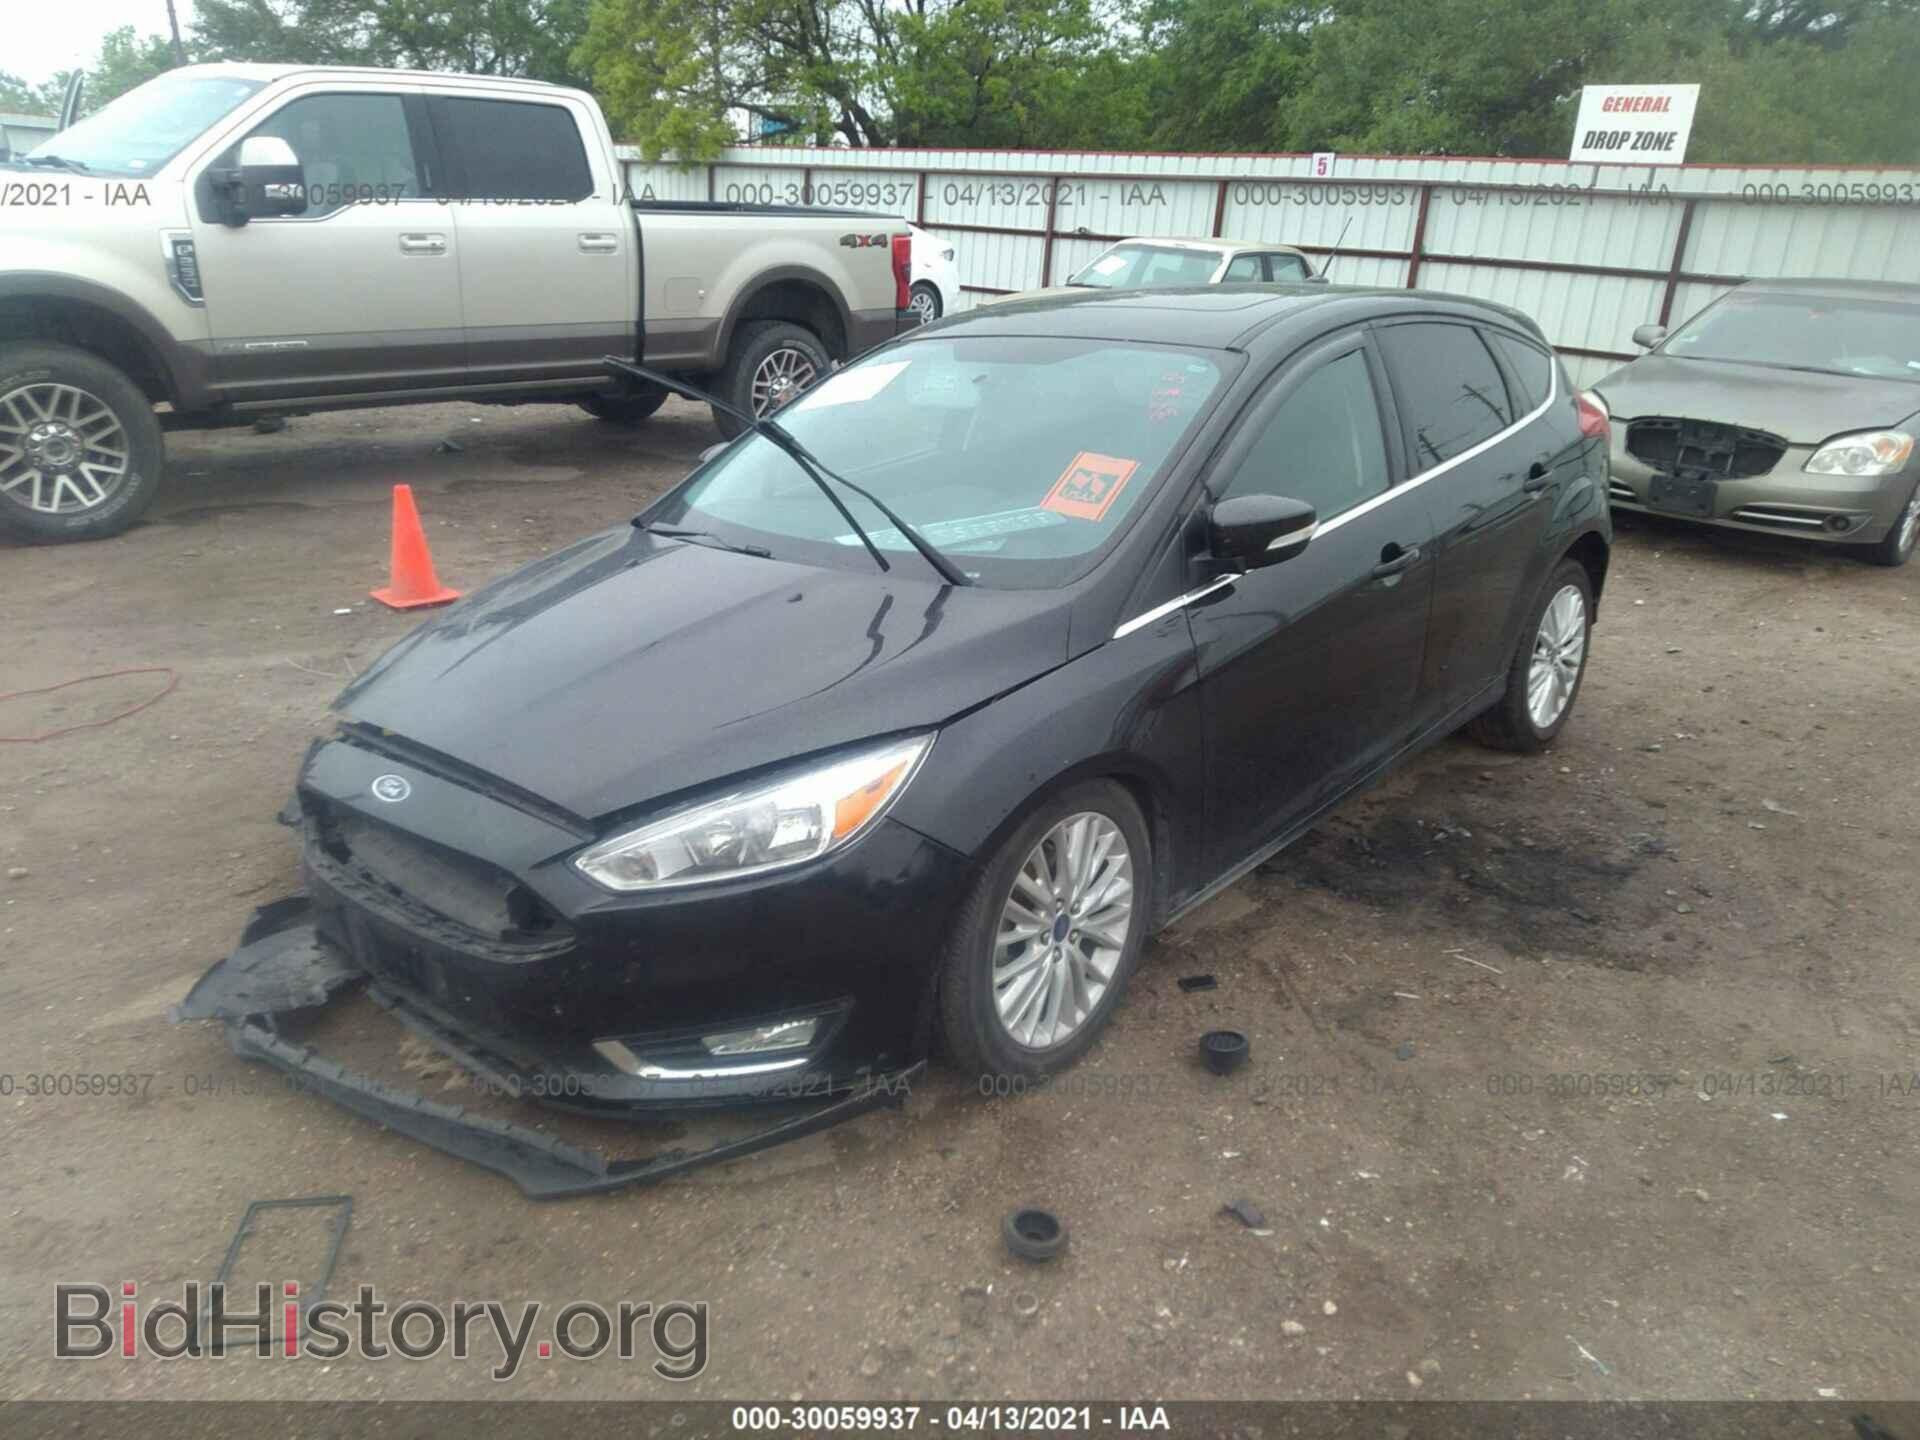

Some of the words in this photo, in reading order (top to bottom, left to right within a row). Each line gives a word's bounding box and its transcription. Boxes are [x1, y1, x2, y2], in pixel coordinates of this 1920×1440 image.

[1602, 96, 1673, 113] GENERAL
[1581, 130, 1632, 150] DROP
[1630, 131, 1679, 151] ZONE
[1317, 156, 1328, 176] 5
